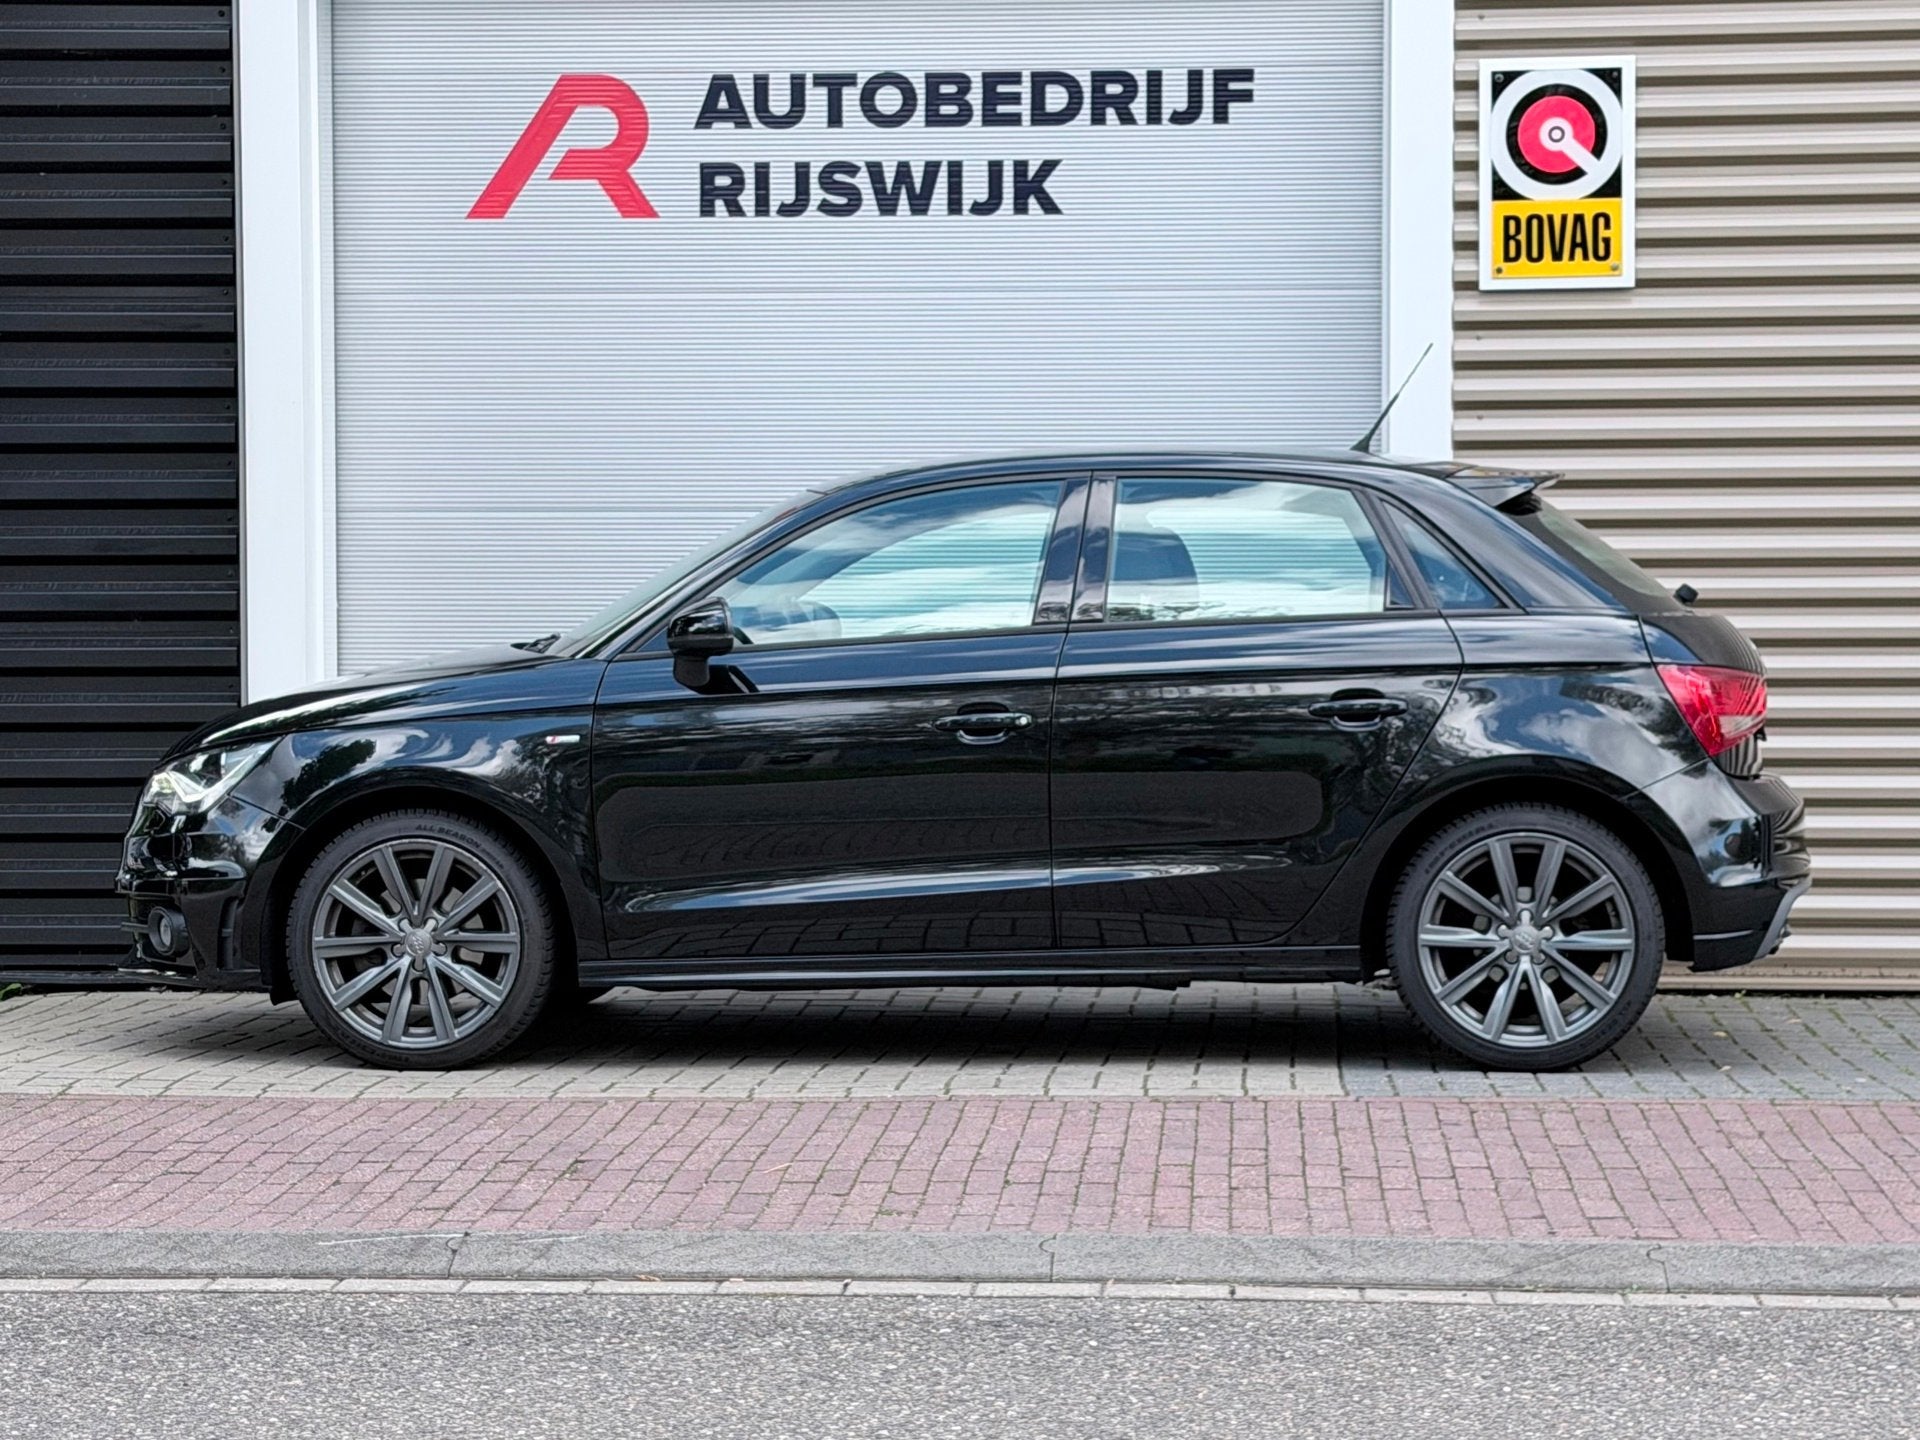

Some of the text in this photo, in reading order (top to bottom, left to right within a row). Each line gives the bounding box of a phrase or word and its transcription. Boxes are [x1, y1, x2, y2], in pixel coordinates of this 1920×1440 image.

[695, 69, 1254, 129] AUTOBEDRIJF
[700, 160, 1061, 217] RIJSWIJK
[1504, 213, 1610, 262] BOVAG
